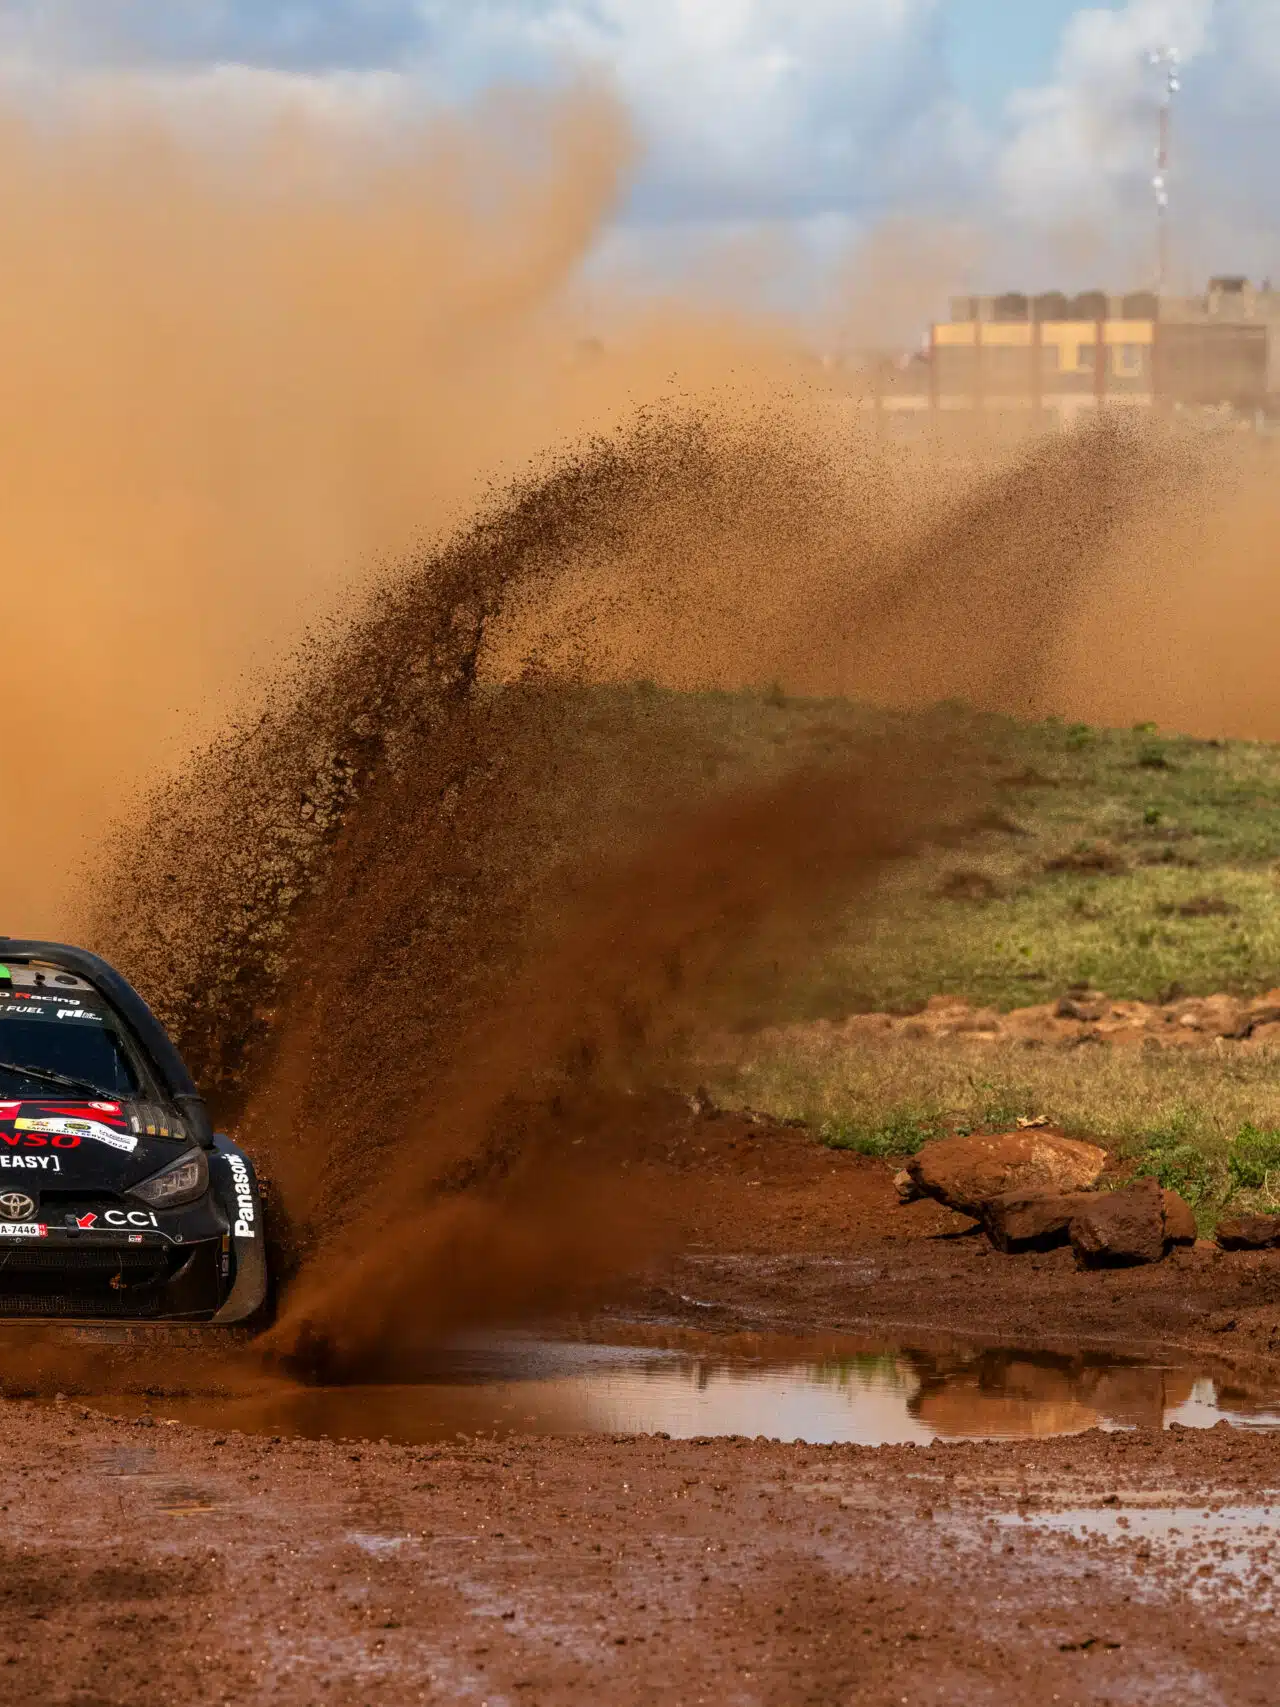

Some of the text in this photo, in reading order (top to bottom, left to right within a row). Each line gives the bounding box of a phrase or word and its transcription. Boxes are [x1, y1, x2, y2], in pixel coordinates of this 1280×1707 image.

[15, 992, 81, 1006] Racing
[6, 1005, 45, 1014] FUEL
[1, 1225, 36, 1234] A-7446
